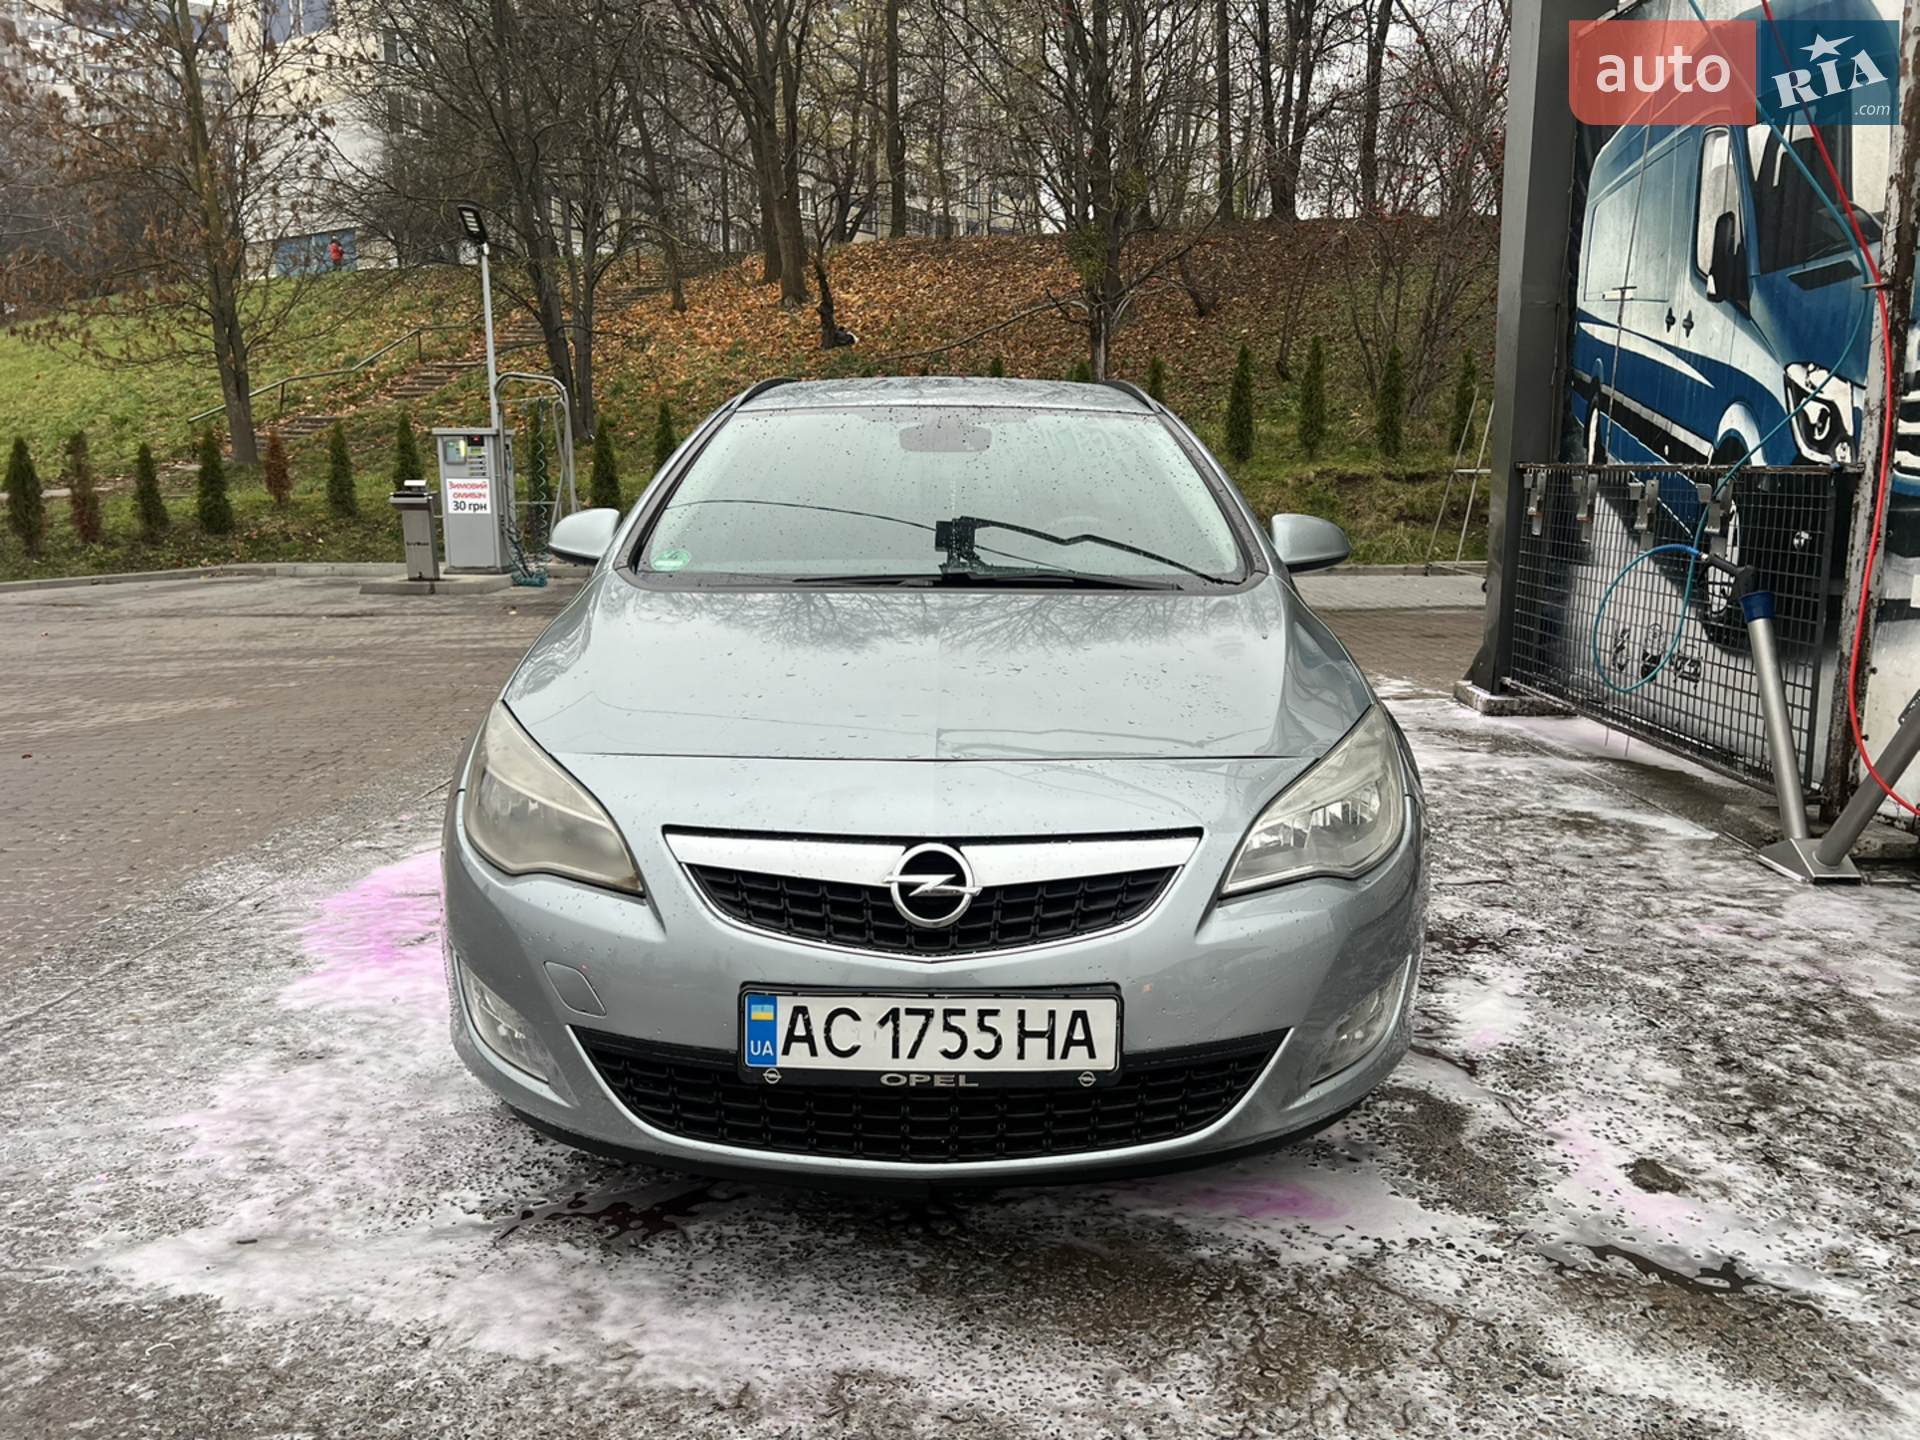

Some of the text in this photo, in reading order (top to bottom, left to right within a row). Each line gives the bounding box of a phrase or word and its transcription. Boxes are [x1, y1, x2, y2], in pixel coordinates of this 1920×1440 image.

[448, 481, 488, 490] Зимовий
[452, 500, 488, 513] 30 грн
[781, 1005, 1097, 1060] AC 1755 HA
[750, 1040, 774, 1057] UA
[879, 1073, 979, 1088] OPEL
